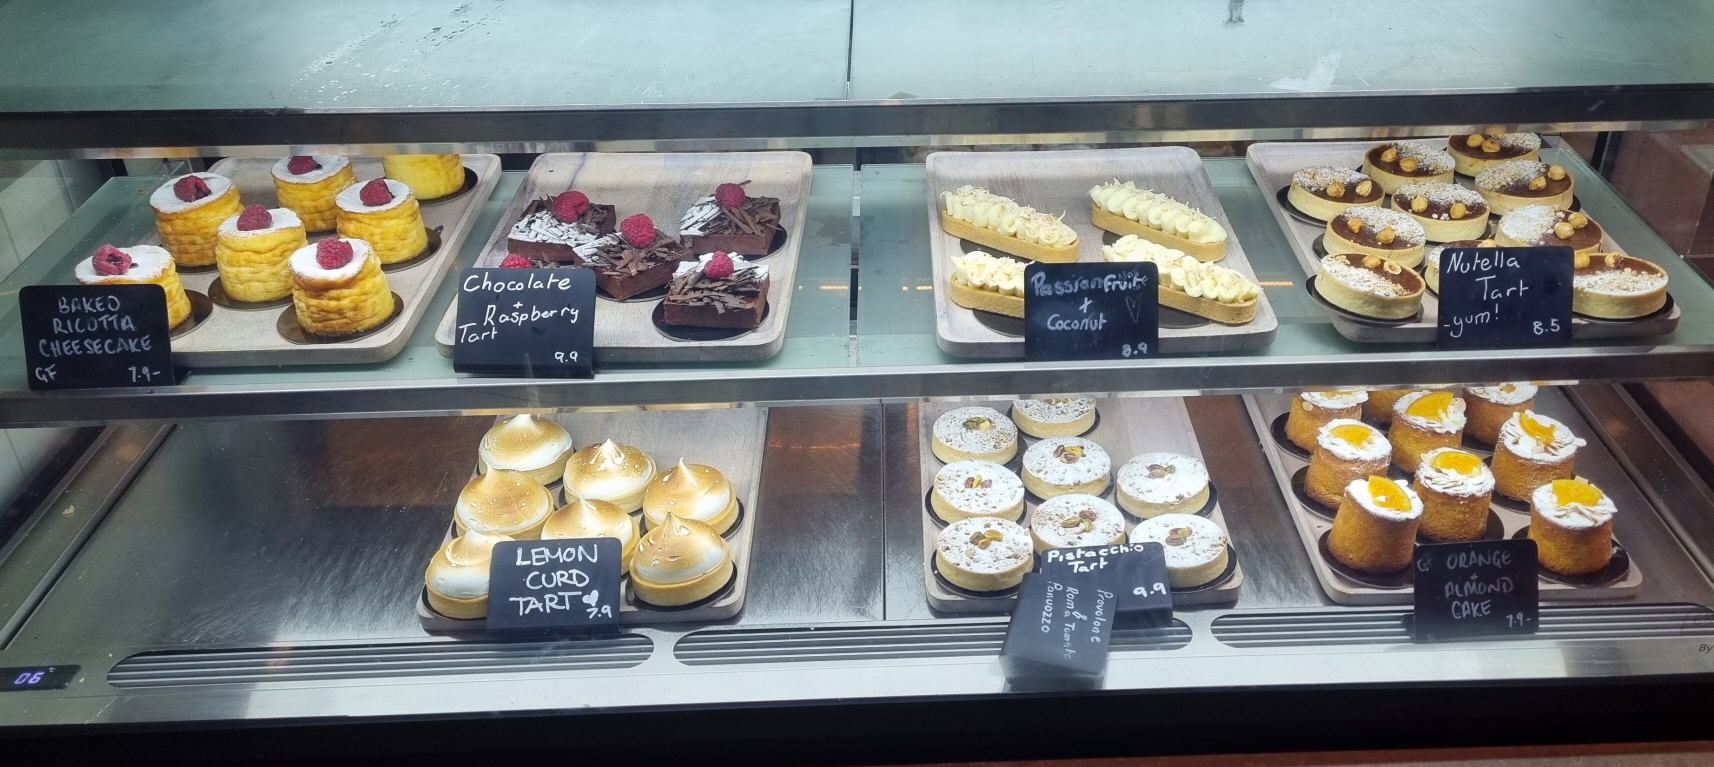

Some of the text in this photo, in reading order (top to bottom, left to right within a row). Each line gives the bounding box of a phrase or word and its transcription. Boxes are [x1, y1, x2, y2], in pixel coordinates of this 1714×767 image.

[1446, 250, 1520, 273] Nutella
[463, 272, 571, 292] Chocolate
[1475, 275, 1529, 300] Tart
[58, 295, 120, 314] BAKED
[52, 314, 137, 334] RICOTTA
[483, 304, 579, 326] Raspberry
[1047, 312, 1107, 331] Coconut
[458, 323, 498, 343] Tart
[1533, 318, 1560, 335] 8.5
[38, 335, 152, 358] CHEESECAKE
[1121, 341, 1148, 357] 8.9
[554, 351, 578, 363] 9.9
[35, 364, 57, 383] GF
[515, 544, 598, 566] LEMON
[1047, 544, 1144, 563] Pistacchio
[1446, 550, 1512, 569] ORANGE
[1068, 556, 1109, 574] Tart
[525, 569, 590, 590] CURD
[1444, 576, 1514, 599] ALMOND
[1133, 582, 1167, 598] 9.9
[509, 591, 582, 616] TART
[586, 605, 612, 619] 7.9
[1041, 581, 1064, 633] Panuozzo
[1063, 586, 1080, 618] Roma
[1451, 599, 1492, 619] CAKE
[1090, 589, 1114, 643] Provolone
[1698, 643, 1714, 654] By
[14, 671, 45, 685] 06
